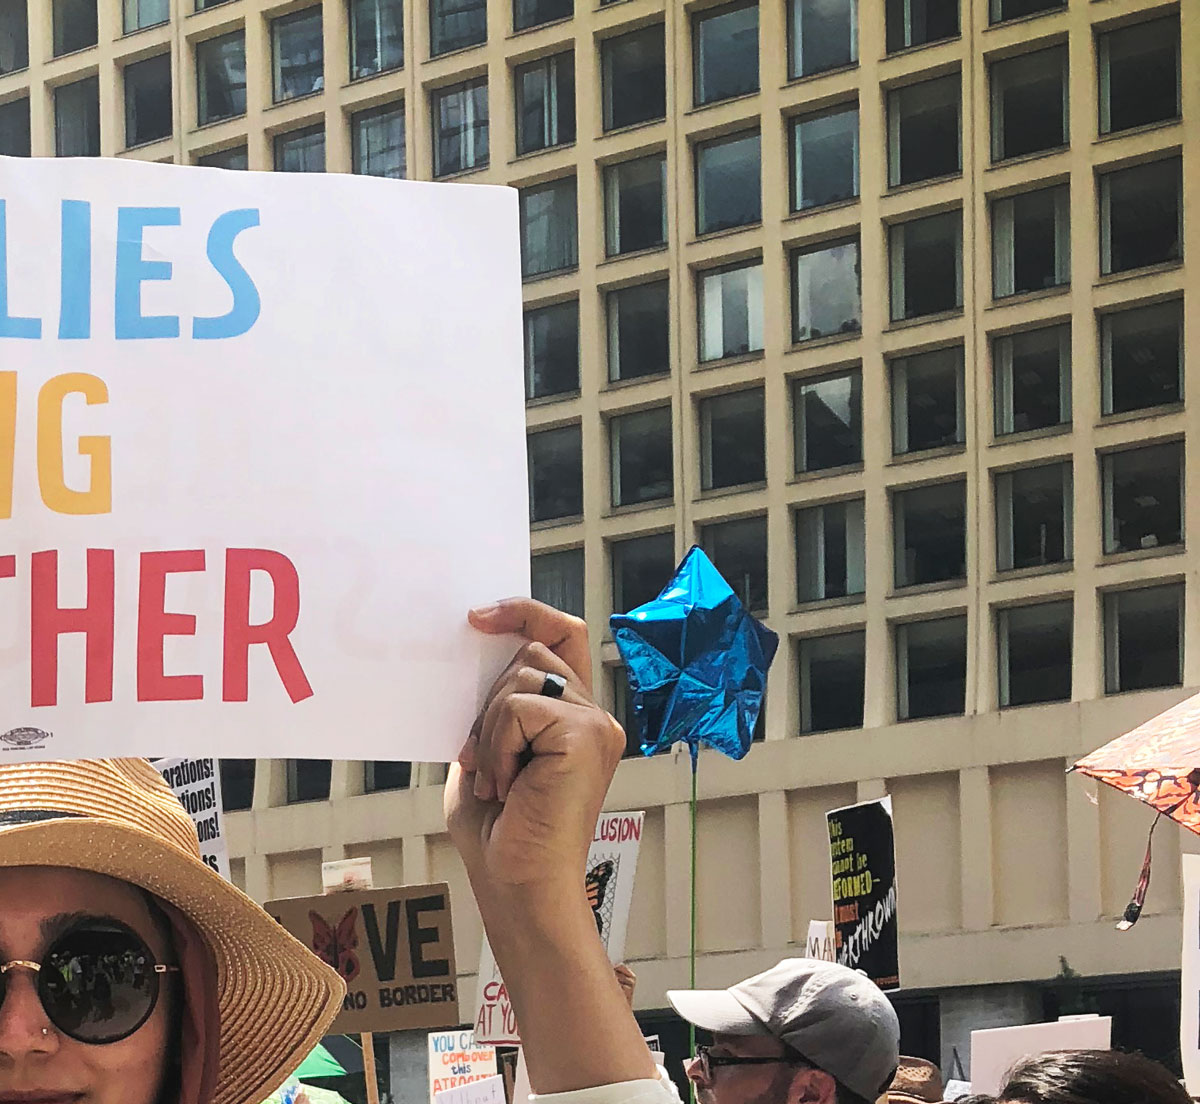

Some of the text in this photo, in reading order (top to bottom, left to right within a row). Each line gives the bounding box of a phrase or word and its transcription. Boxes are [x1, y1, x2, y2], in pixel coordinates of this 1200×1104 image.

[194, 812, 220, 843] ons!
[593, 817, 641, 843] USION
[378, 983, 456, 1009] BORDER
[475, 1003, 497, 1036] AT
[432, 1035, 455, 1053] YOU
